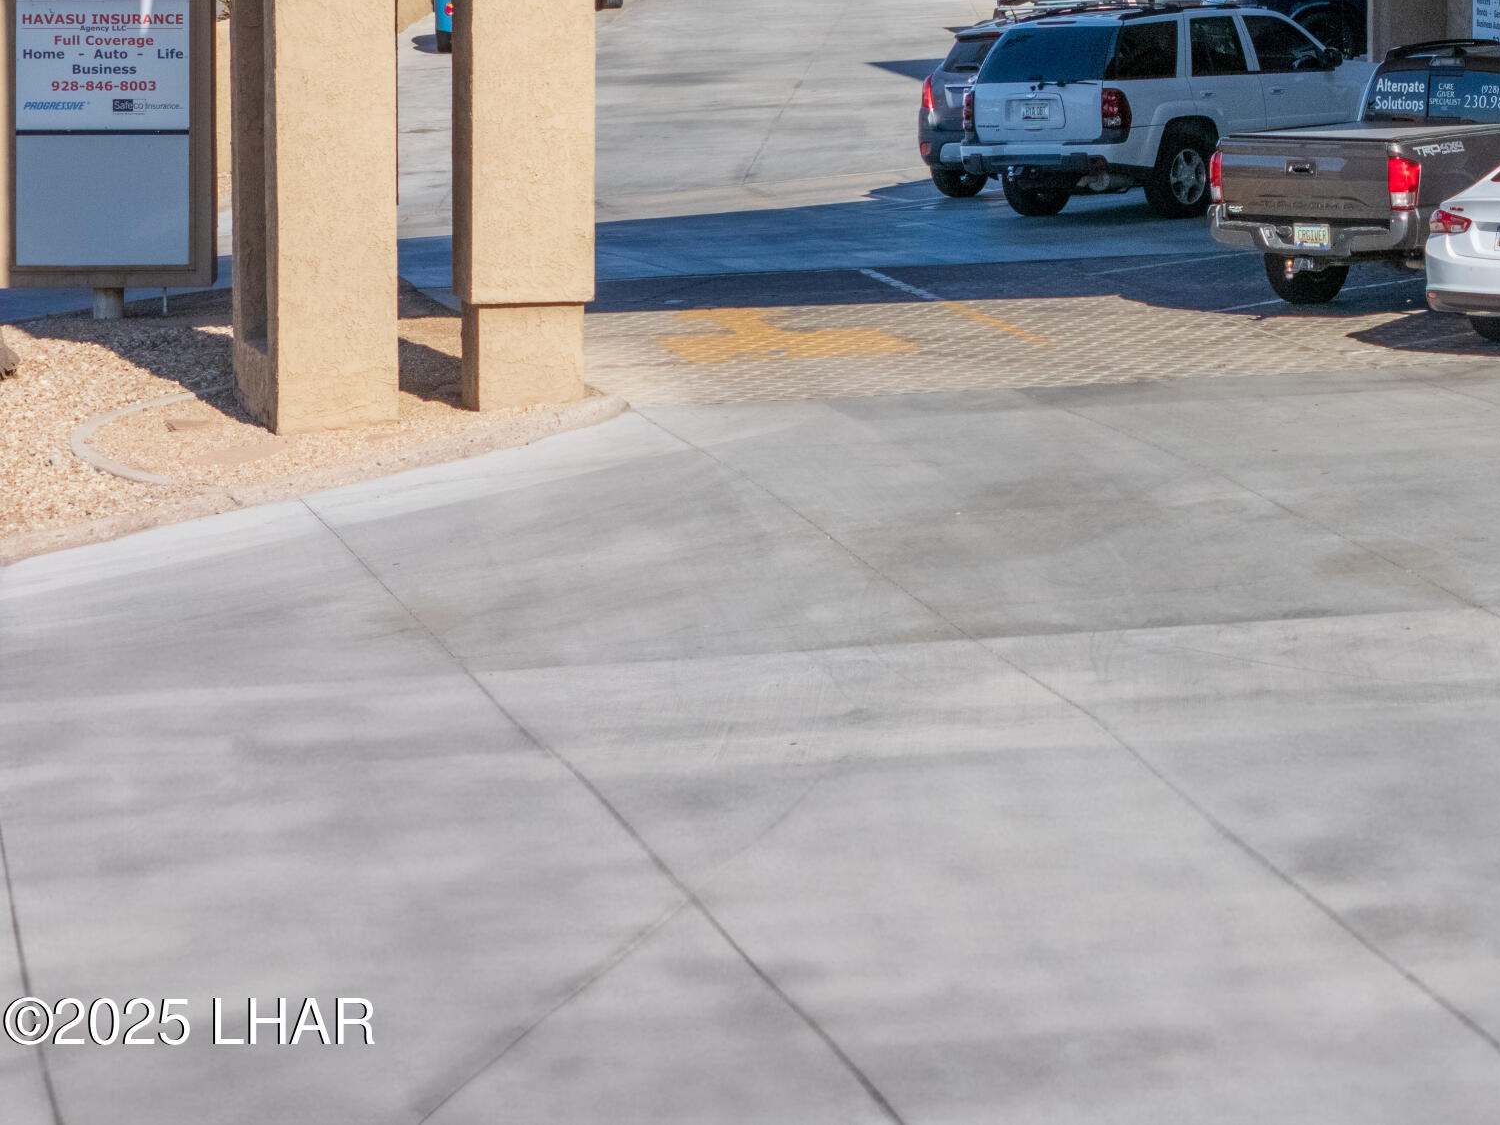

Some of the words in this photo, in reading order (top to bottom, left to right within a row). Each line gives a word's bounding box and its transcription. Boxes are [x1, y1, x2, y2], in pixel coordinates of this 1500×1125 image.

[22, 14, 86, 25] HAVASU
[92, 14, 184, 25] INSURANCE
[80, 25, 109, 33] Agency
[54, 35, 80, 46] Full
[86, 35, 154, 48] Coverage
[23, 49, 65, 59] Home
[94, 49, 128, 59] Auto
[157, 49, 184, 59] Life
[72, 64, 137, 75] Business
[51, 80, 157, 91] 928-846-8003
[1376, 78, 1425, 94] Alternate
[1438, 83, 1454, 91] CARE
[1481, 85, 1500, 94] (928)
[23, 101, 87, 111] PROGRESSIVE
[113, 100, 144, 110] Safeco
[1375, 96, 1424, 112] Solutions
